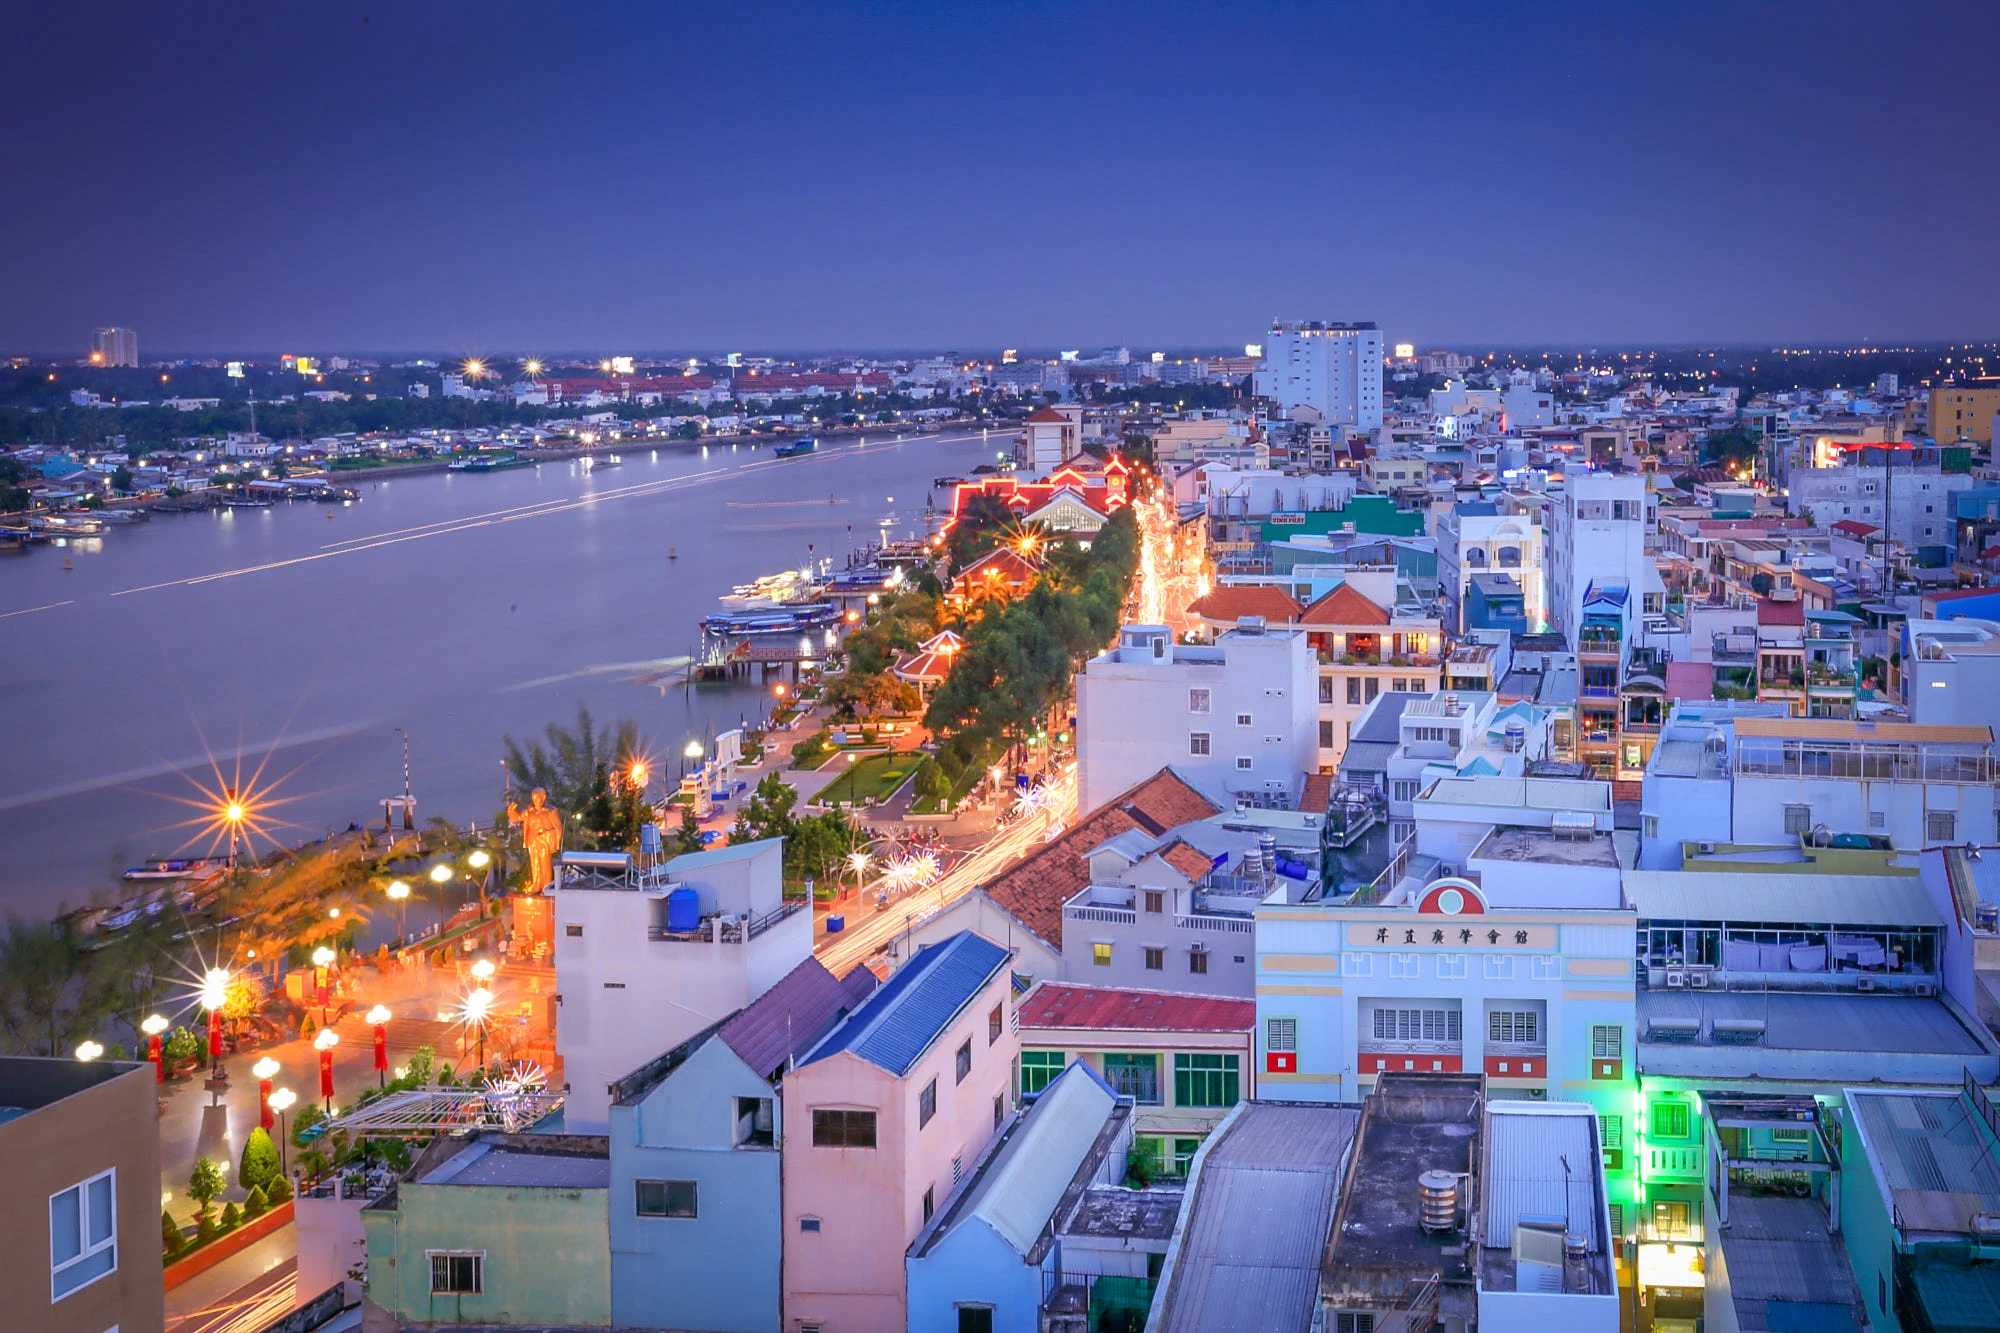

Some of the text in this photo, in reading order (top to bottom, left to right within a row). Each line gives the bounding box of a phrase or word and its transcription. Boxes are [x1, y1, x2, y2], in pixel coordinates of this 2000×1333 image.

[1376, 927, 1528, 944] 芹苴廣肇會館
